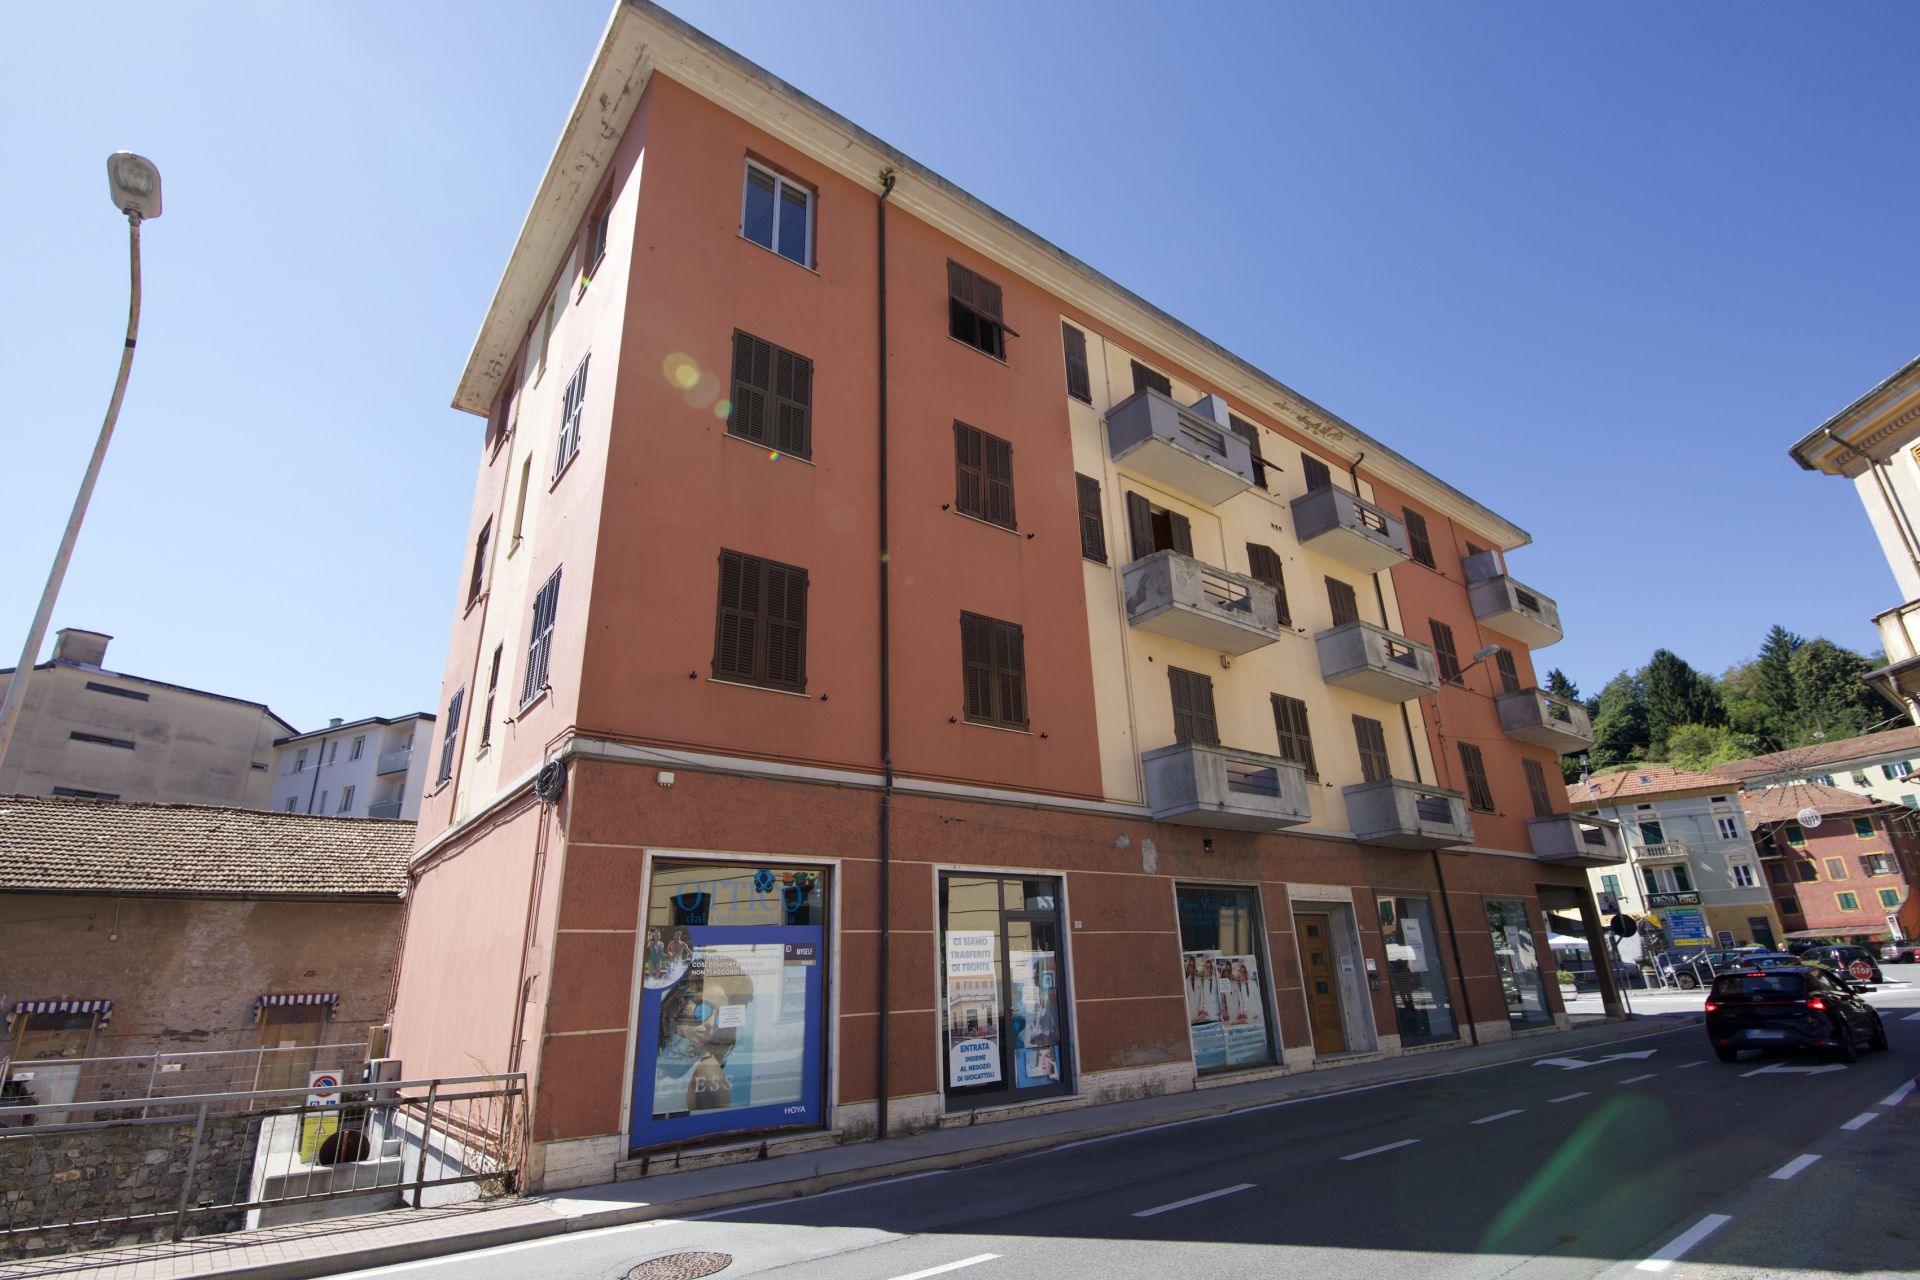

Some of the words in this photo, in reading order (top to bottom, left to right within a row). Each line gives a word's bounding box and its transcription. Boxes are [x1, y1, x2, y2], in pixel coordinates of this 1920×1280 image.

[676, 879, 802, 912] OTTICO
[686, 911, 705, 924] dal
[953, 938, 962, 946] CI
[963, 937, 988, 946] SIAMO
[796, 947, 814, 956] MYSELF
[950, 950, 992, 959] TRASFERITI
[962, 961, 991, 972] FRONTE
[1851, 966, 1871, 975] STOP
[960, 1042, 990, 1053] ENTRATA
[965, 1054, 986, 1062] INSIEME
[968, 1062, 992, 1071] NEGOZIO
[956, 1075, 964, 1083] DI
[964, 1071, 995, 1081] GIOCATTOLI
[784, 1106, 806, 1115] HOYA
